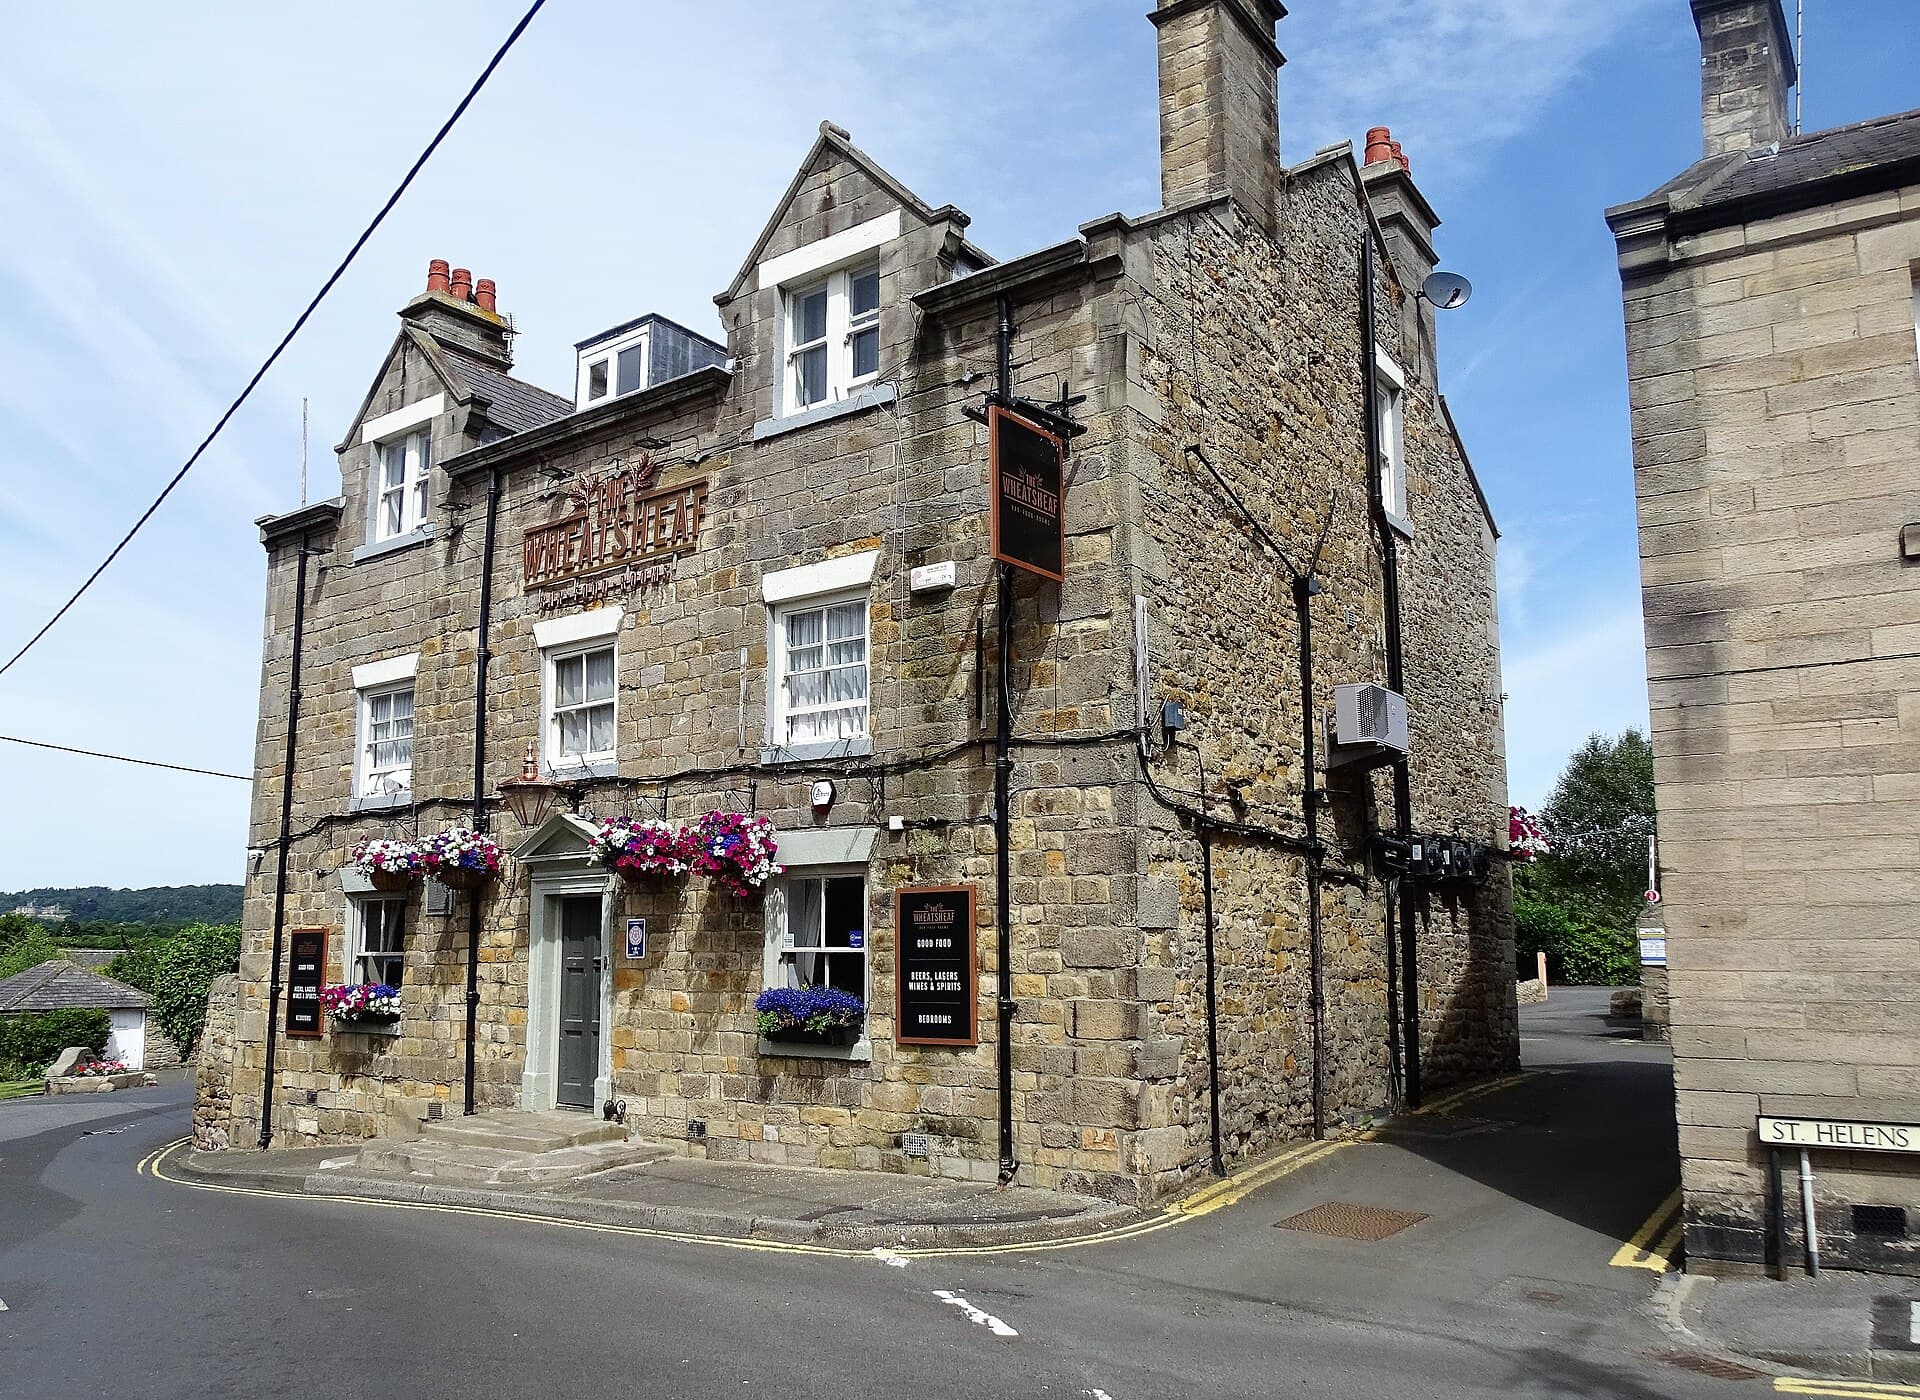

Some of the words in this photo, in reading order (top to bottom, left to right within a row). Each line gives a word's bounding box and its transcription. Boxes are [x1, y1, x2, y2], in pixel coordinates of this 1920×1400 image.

[597, 475, 628, 512] THE
[1003, 476, 1057, 514] WHEATSHEAF
[524, 489, 709, 581] WHEATSHEAF
[913, 912, 955, 922] WHEATSHEAF
[917, 939, 934, 948] GOOD
[936, 939, 951, 948] FOOD
[911, 971, 933, 981] BEERS,
[935, 972, 958, 981] LAGERS
[908, 982, 928, 991] WINES
[929, 982, 935, 991] &
[936, 982, 961, 991] SPIRITS
[918, 1014, 952, 1024] BEDROOMS
[1772, 1121, 1806, 1141] ST.
[1815, 1123, 1909, 1147] HELENS
